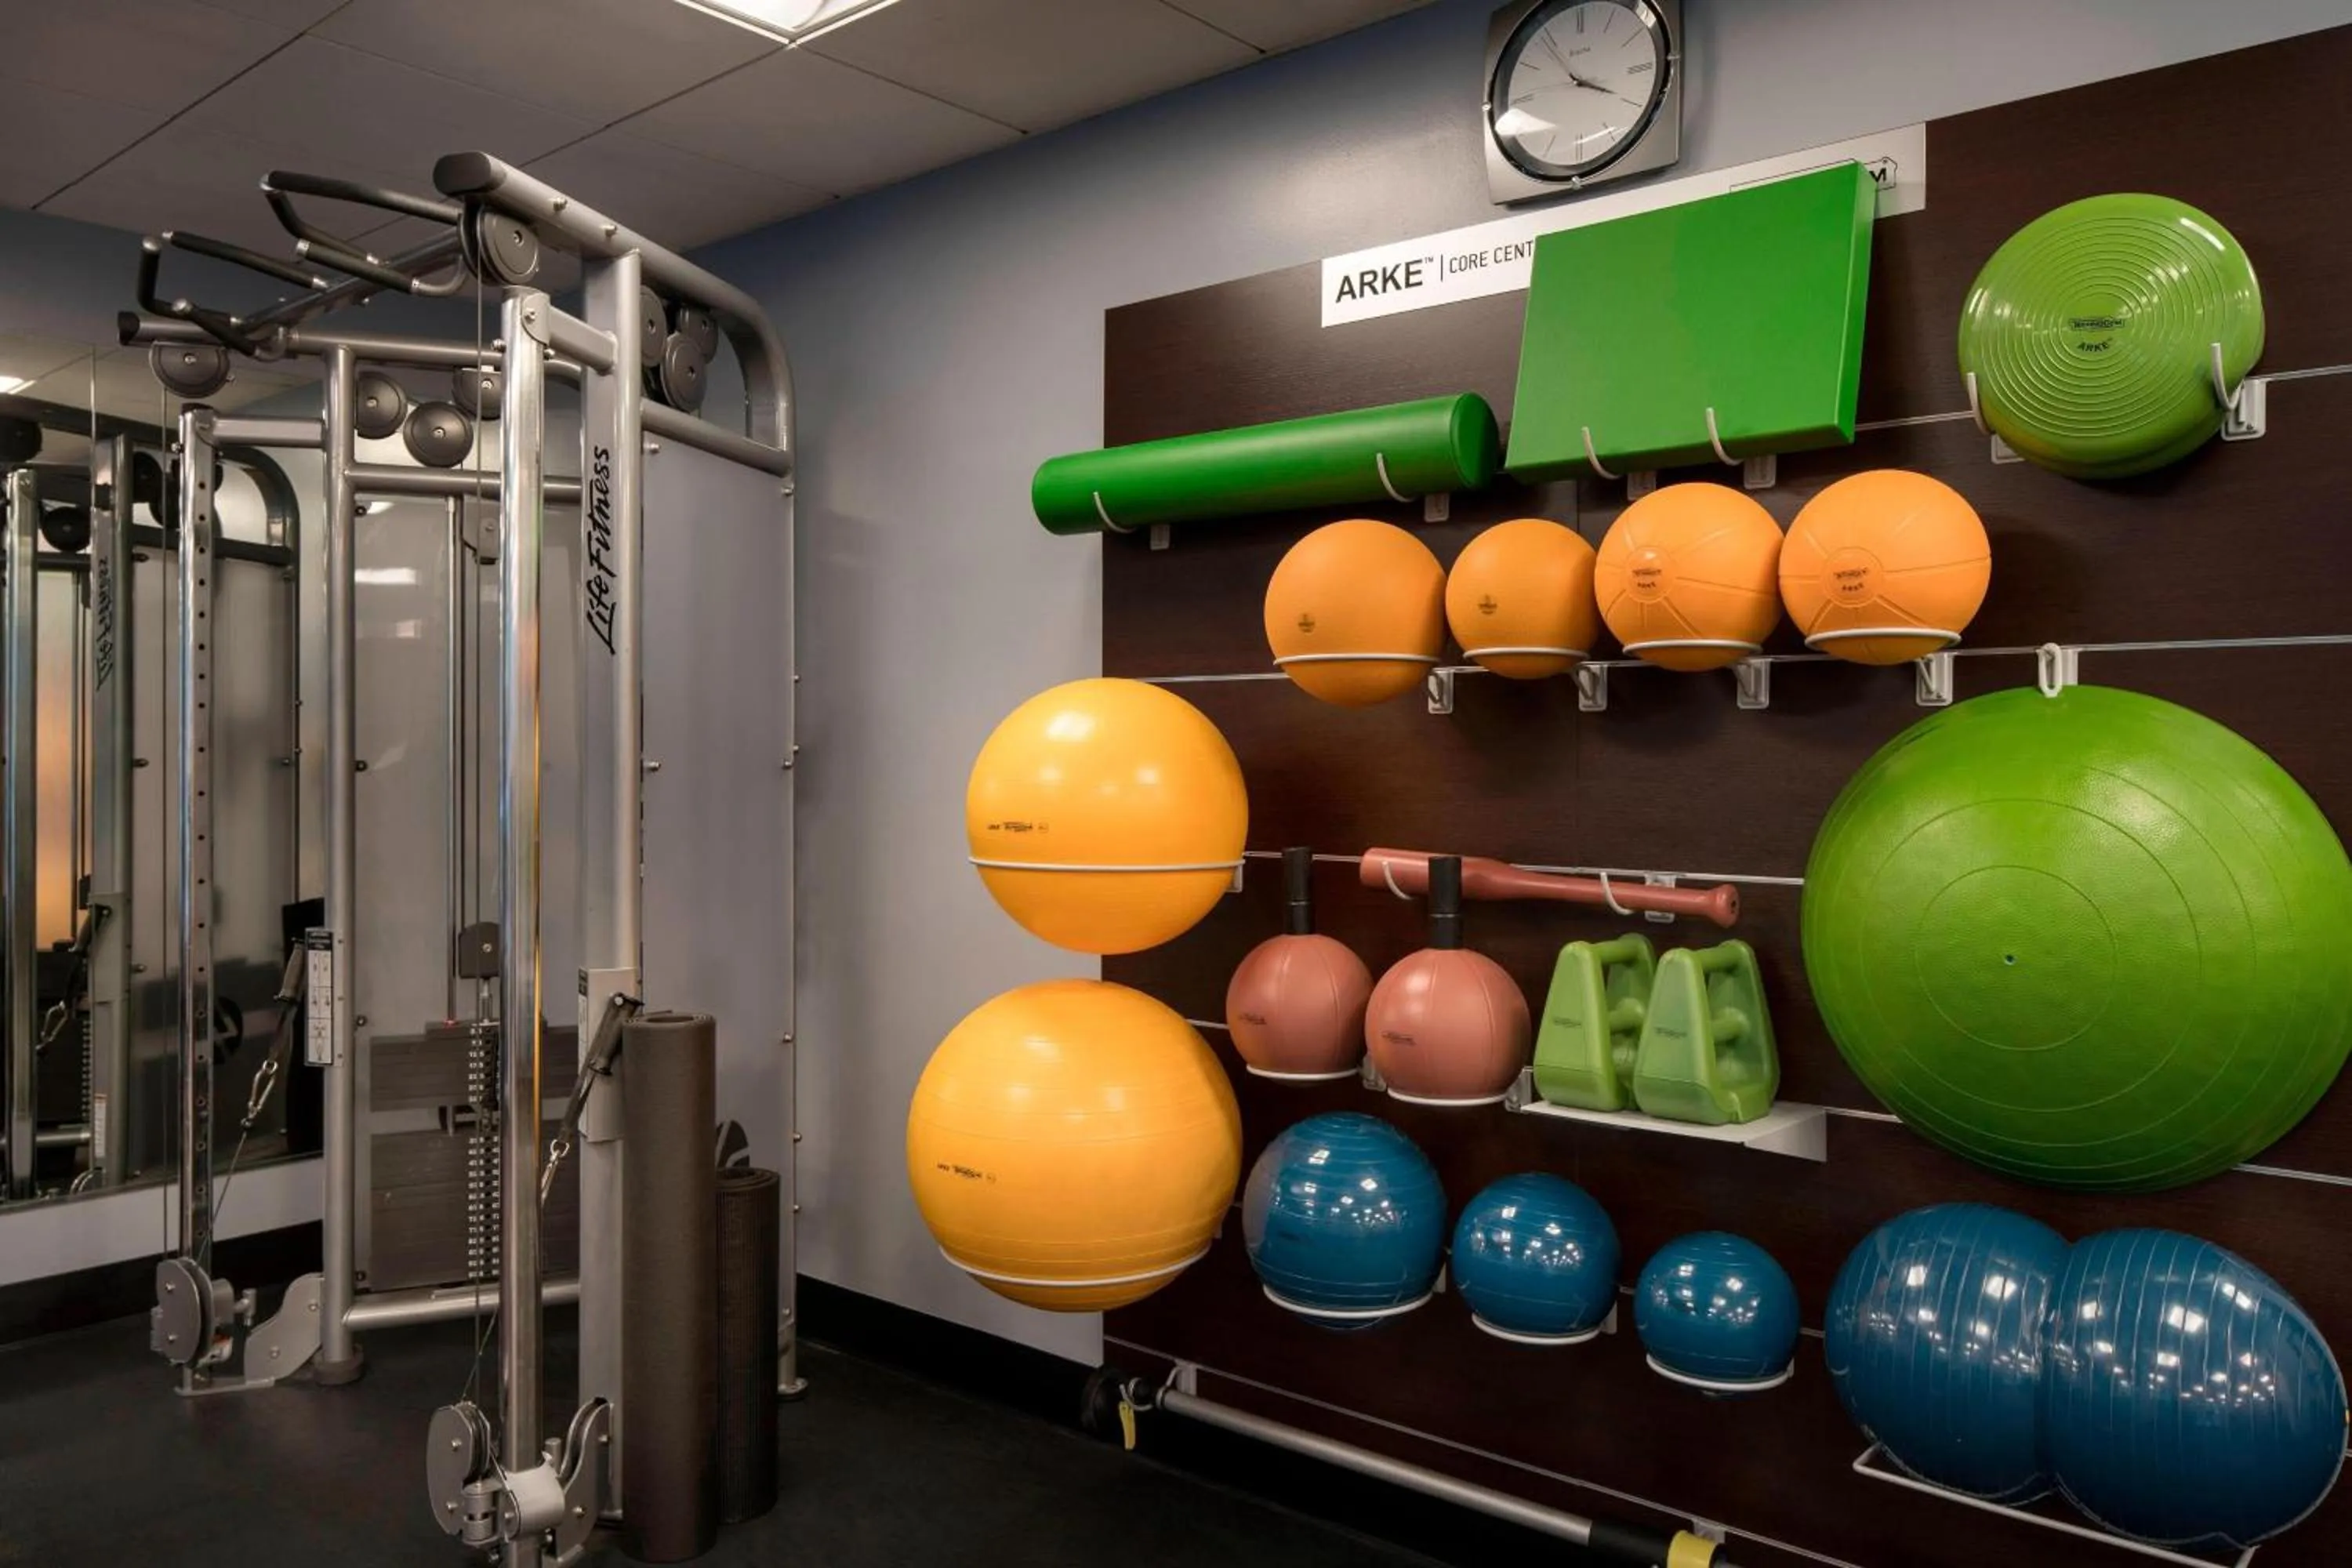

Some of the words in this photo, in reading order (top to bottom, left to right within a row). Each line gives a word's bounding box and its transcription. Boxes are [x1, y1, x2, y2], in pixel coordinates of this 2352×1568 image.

[1449, 250, 1489, 274] CORE
[586, 445, 617, 578] Fitness
[586, 574, 617, 655] Life
